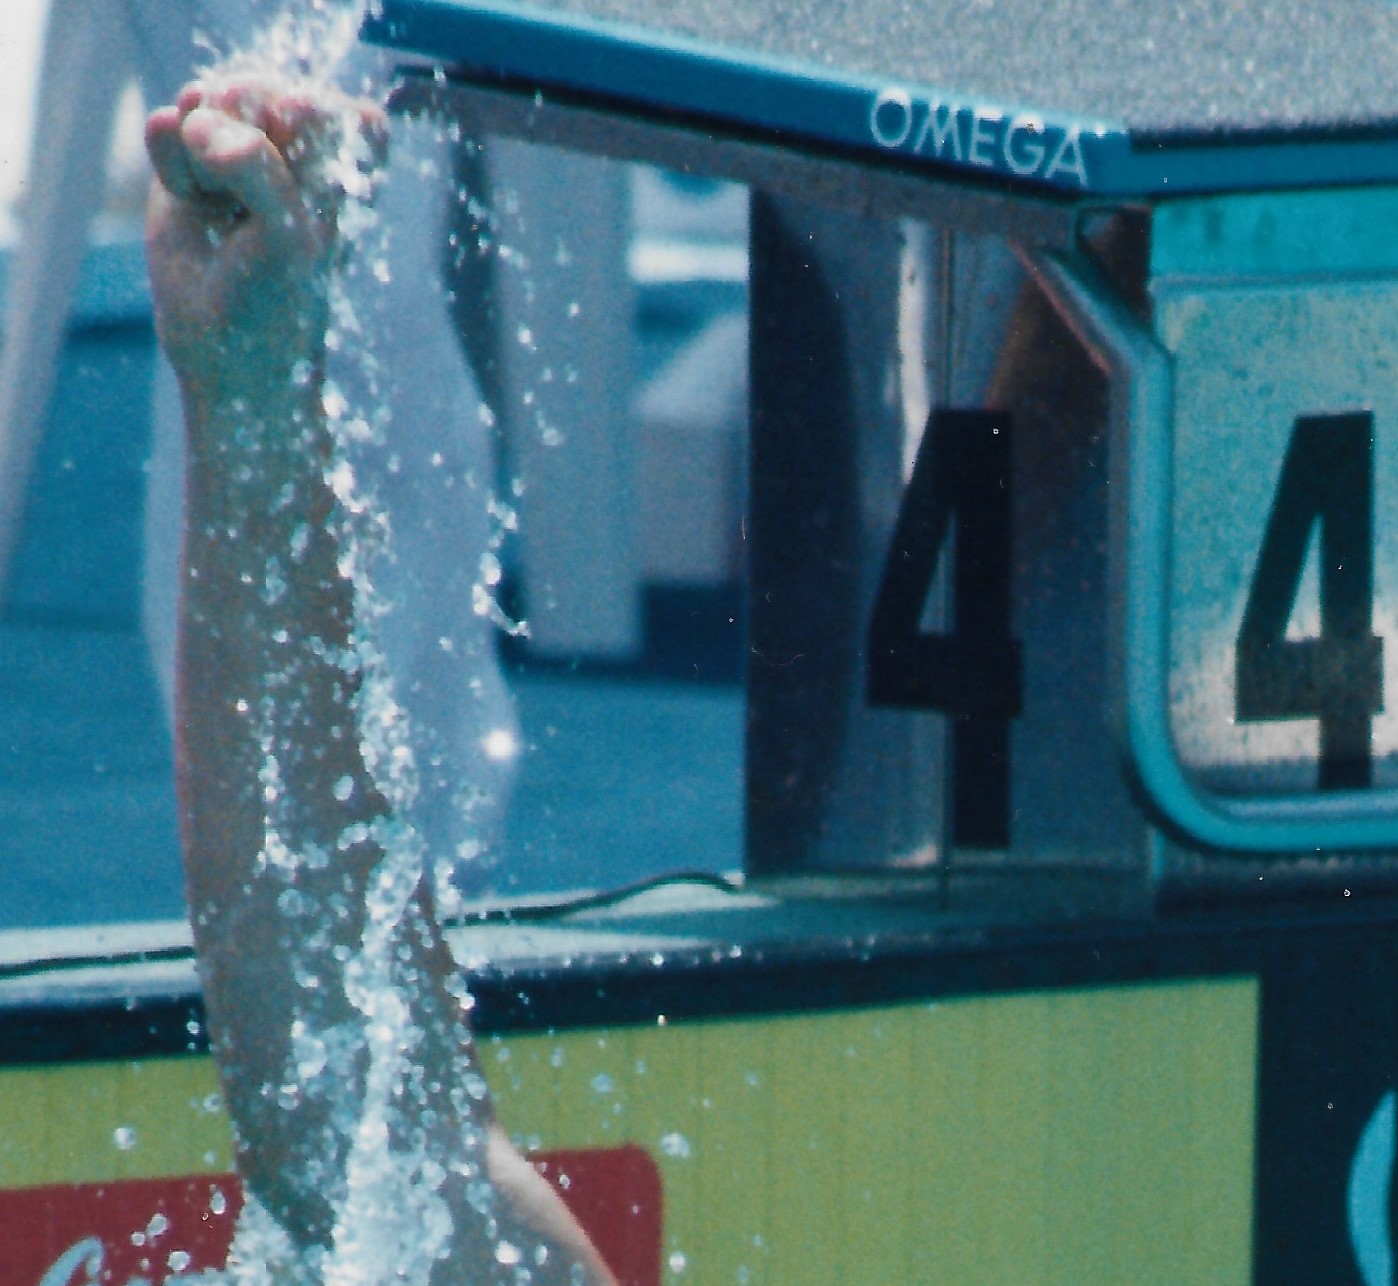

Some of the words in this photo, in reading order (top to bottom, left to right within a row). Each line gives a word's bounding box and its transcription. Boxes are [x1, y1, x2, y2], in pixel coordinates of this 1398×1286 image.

[870, 88, 1088, 187] OMEGA
[868, 408, 1024, 848] 4
[1236, 409, 1384, 788] 4
